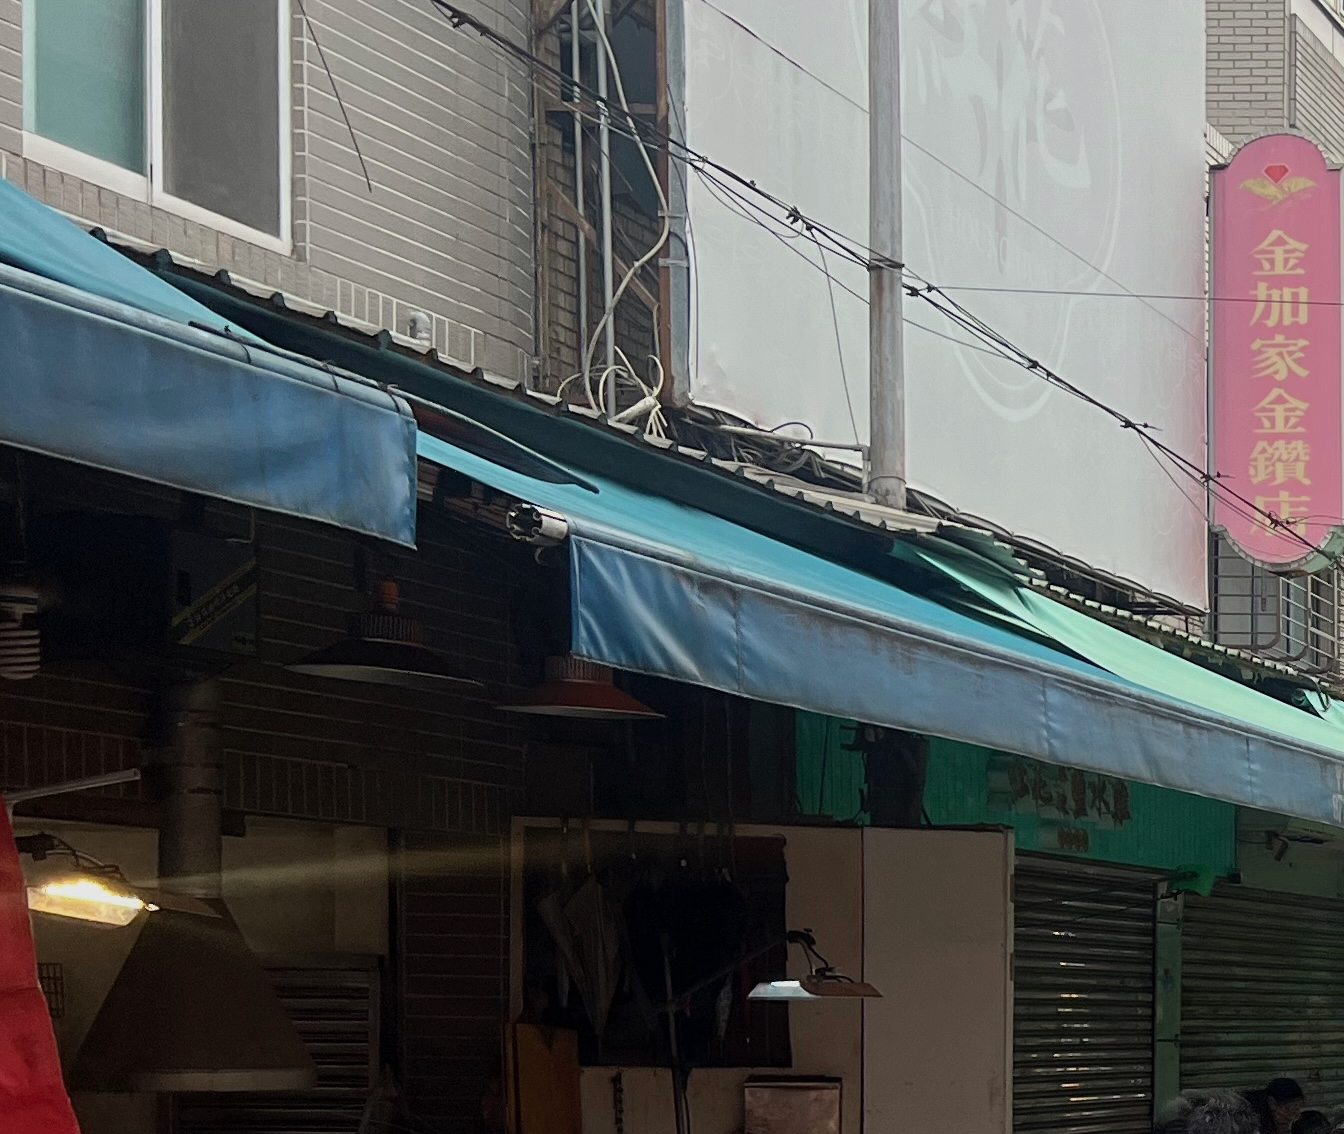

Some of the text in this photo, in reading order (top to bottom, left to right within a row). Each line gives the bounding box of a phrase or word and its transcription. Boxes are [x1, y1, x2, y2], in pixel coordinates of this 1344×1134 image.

[1250, 229, 1312, 537] 金加家金鑽店
